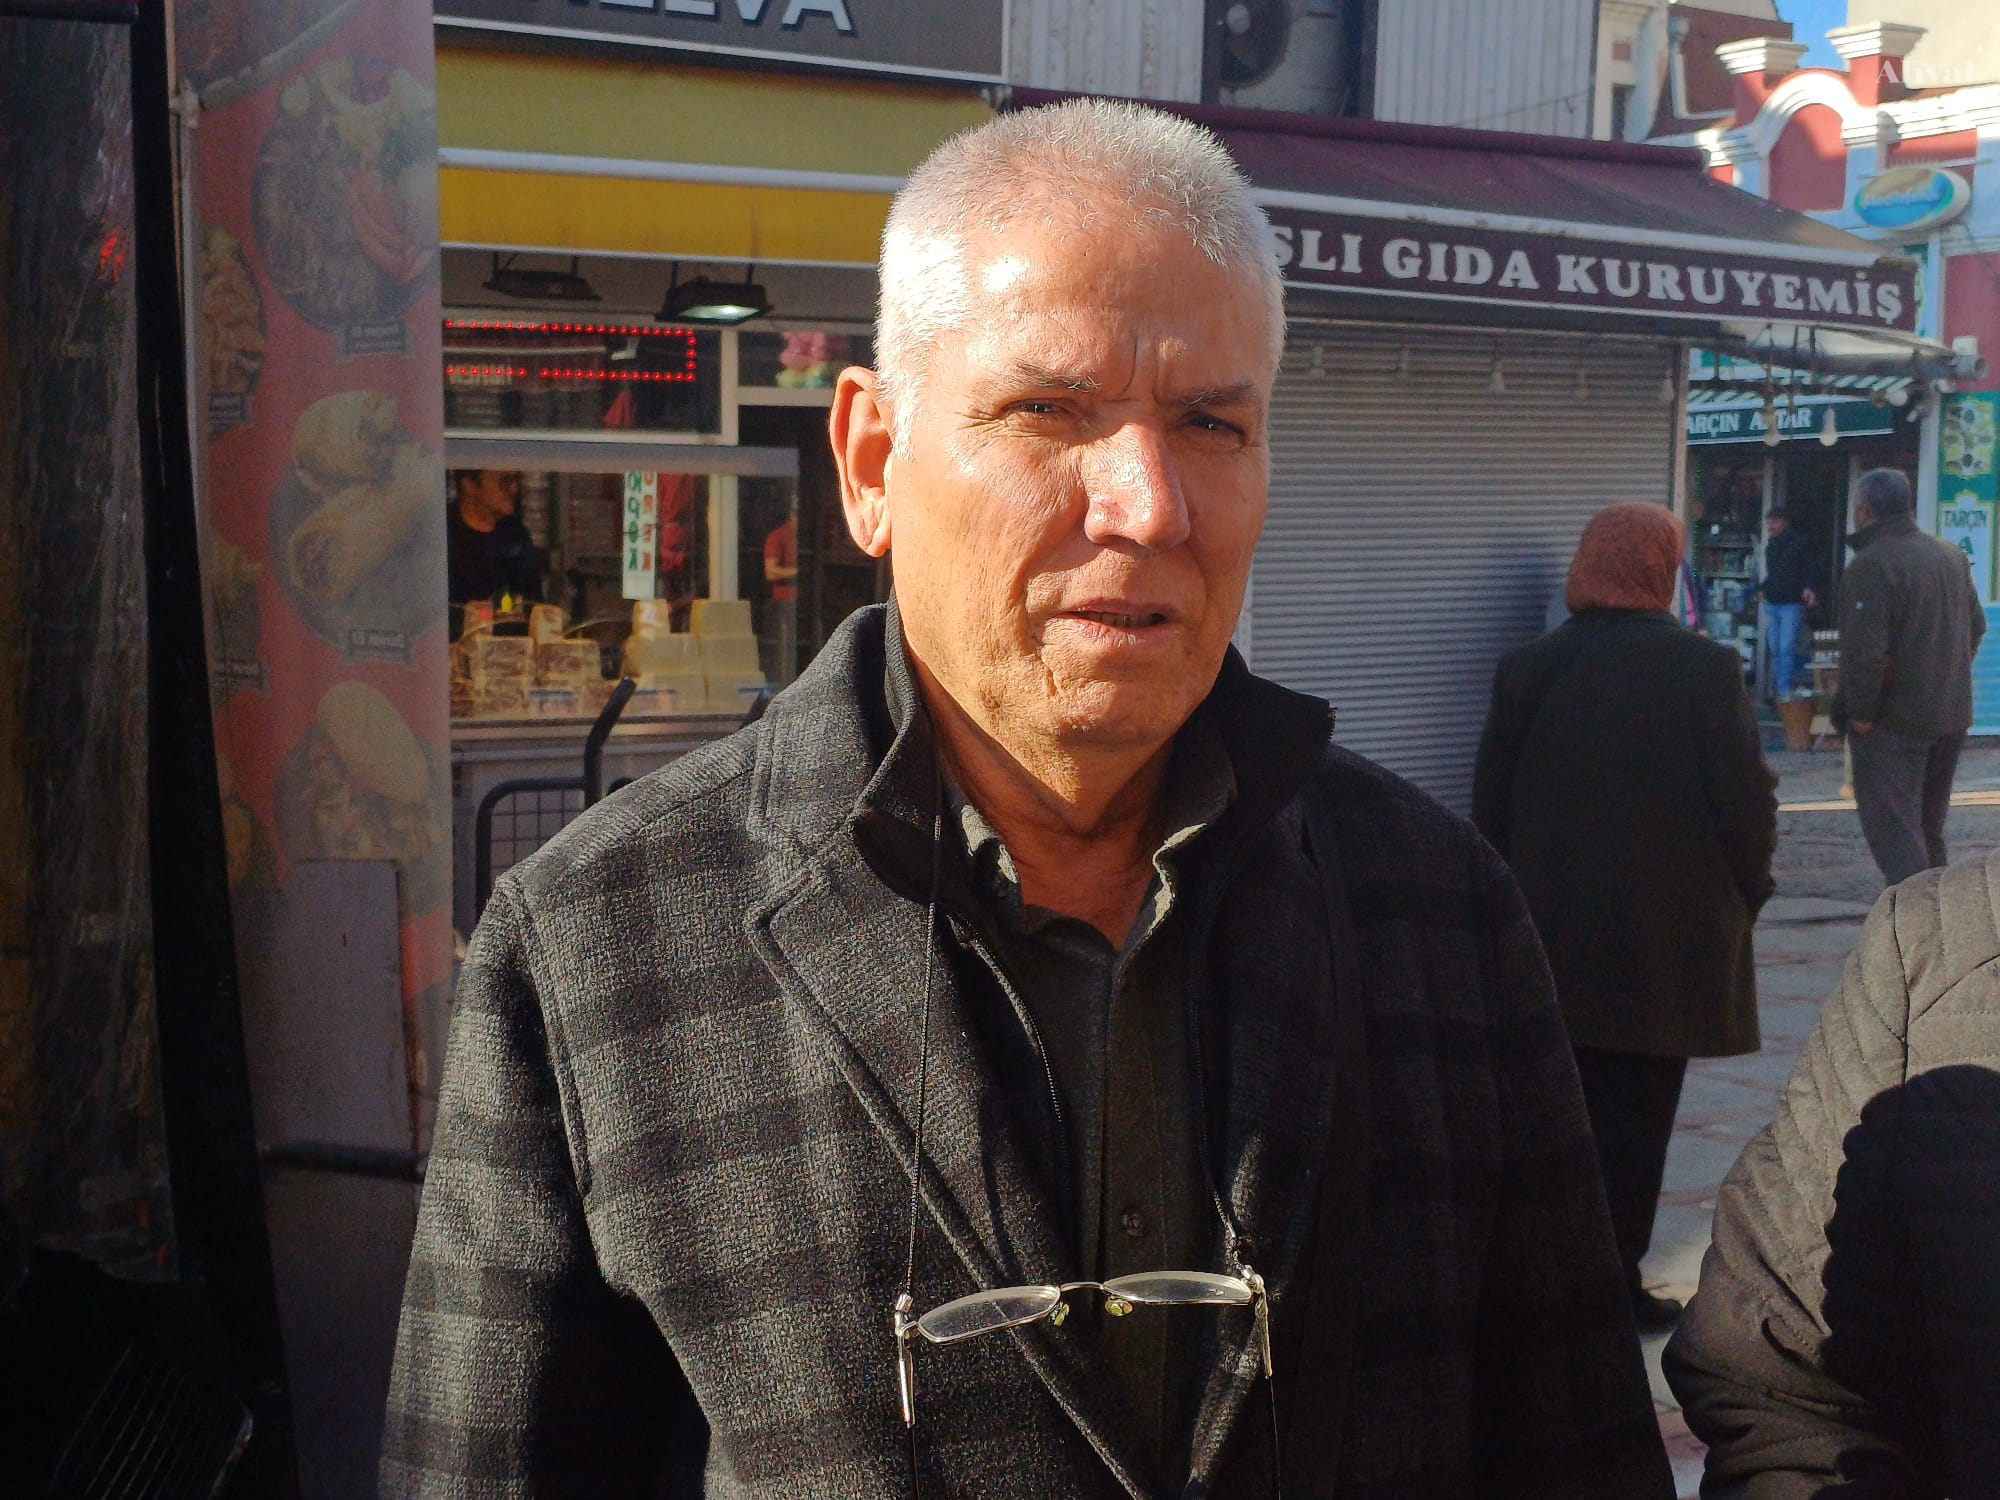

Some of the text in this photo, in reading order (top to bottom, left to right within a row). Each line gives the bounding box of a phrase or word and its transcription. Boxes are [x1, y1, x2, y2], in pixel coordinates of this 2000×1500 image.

[1267, 225, 1903, 325] SLI GIDA KURUYEMİŞ
[1687, 407, 1813, 438] ARÇIN ATAR
